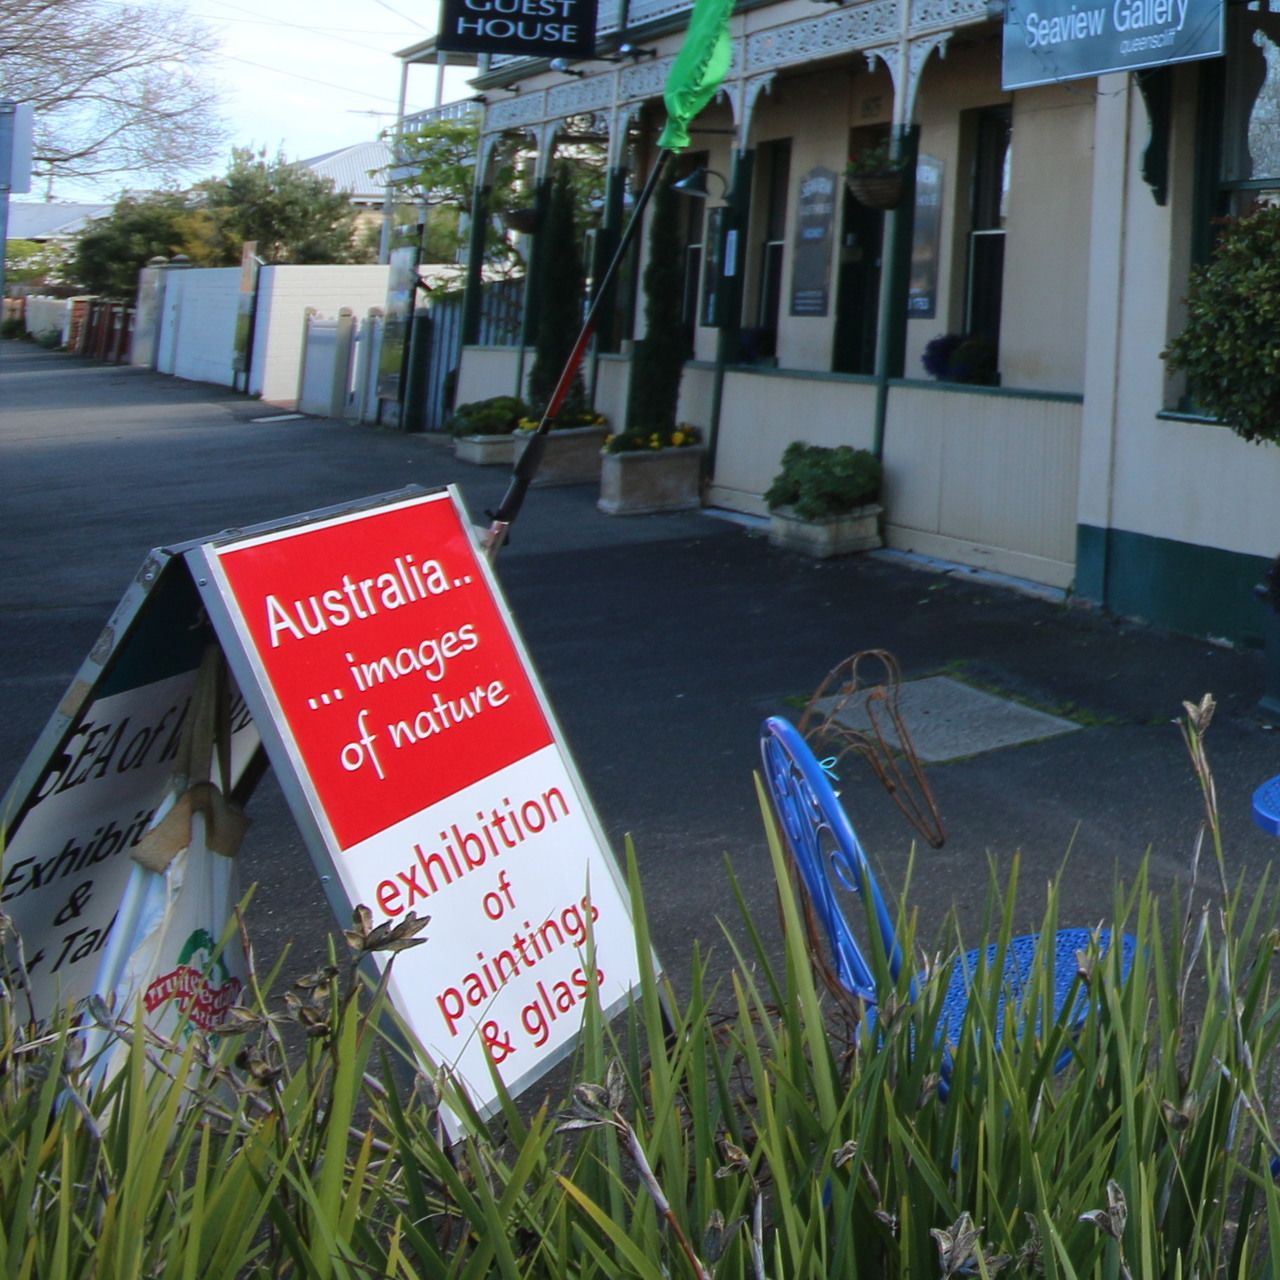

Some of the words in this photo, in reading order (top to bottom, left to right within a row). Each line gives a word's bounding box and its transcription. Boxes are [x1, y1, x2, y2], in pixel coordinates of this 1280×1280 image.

[457, 16, 579, 43] HOUSE
[1024, 5, 1106, 49] Seaview
[1119, 27, 1176, 56] queenscliff
[345, 623, 480, 692] images
[340, 709, 385, 780] of
[388, 679, 511, 749] nature
[0, 807, 157, 902] Exhibit
[375, 785, 570, 917] exhibition
[54, 880, 94, 927] &
[482, 869, 516, 921] of
[51, 909, 119, 973] Tal
[435, 895, 599, 1037] paintings
[481, 1020, 517, 1065] &
